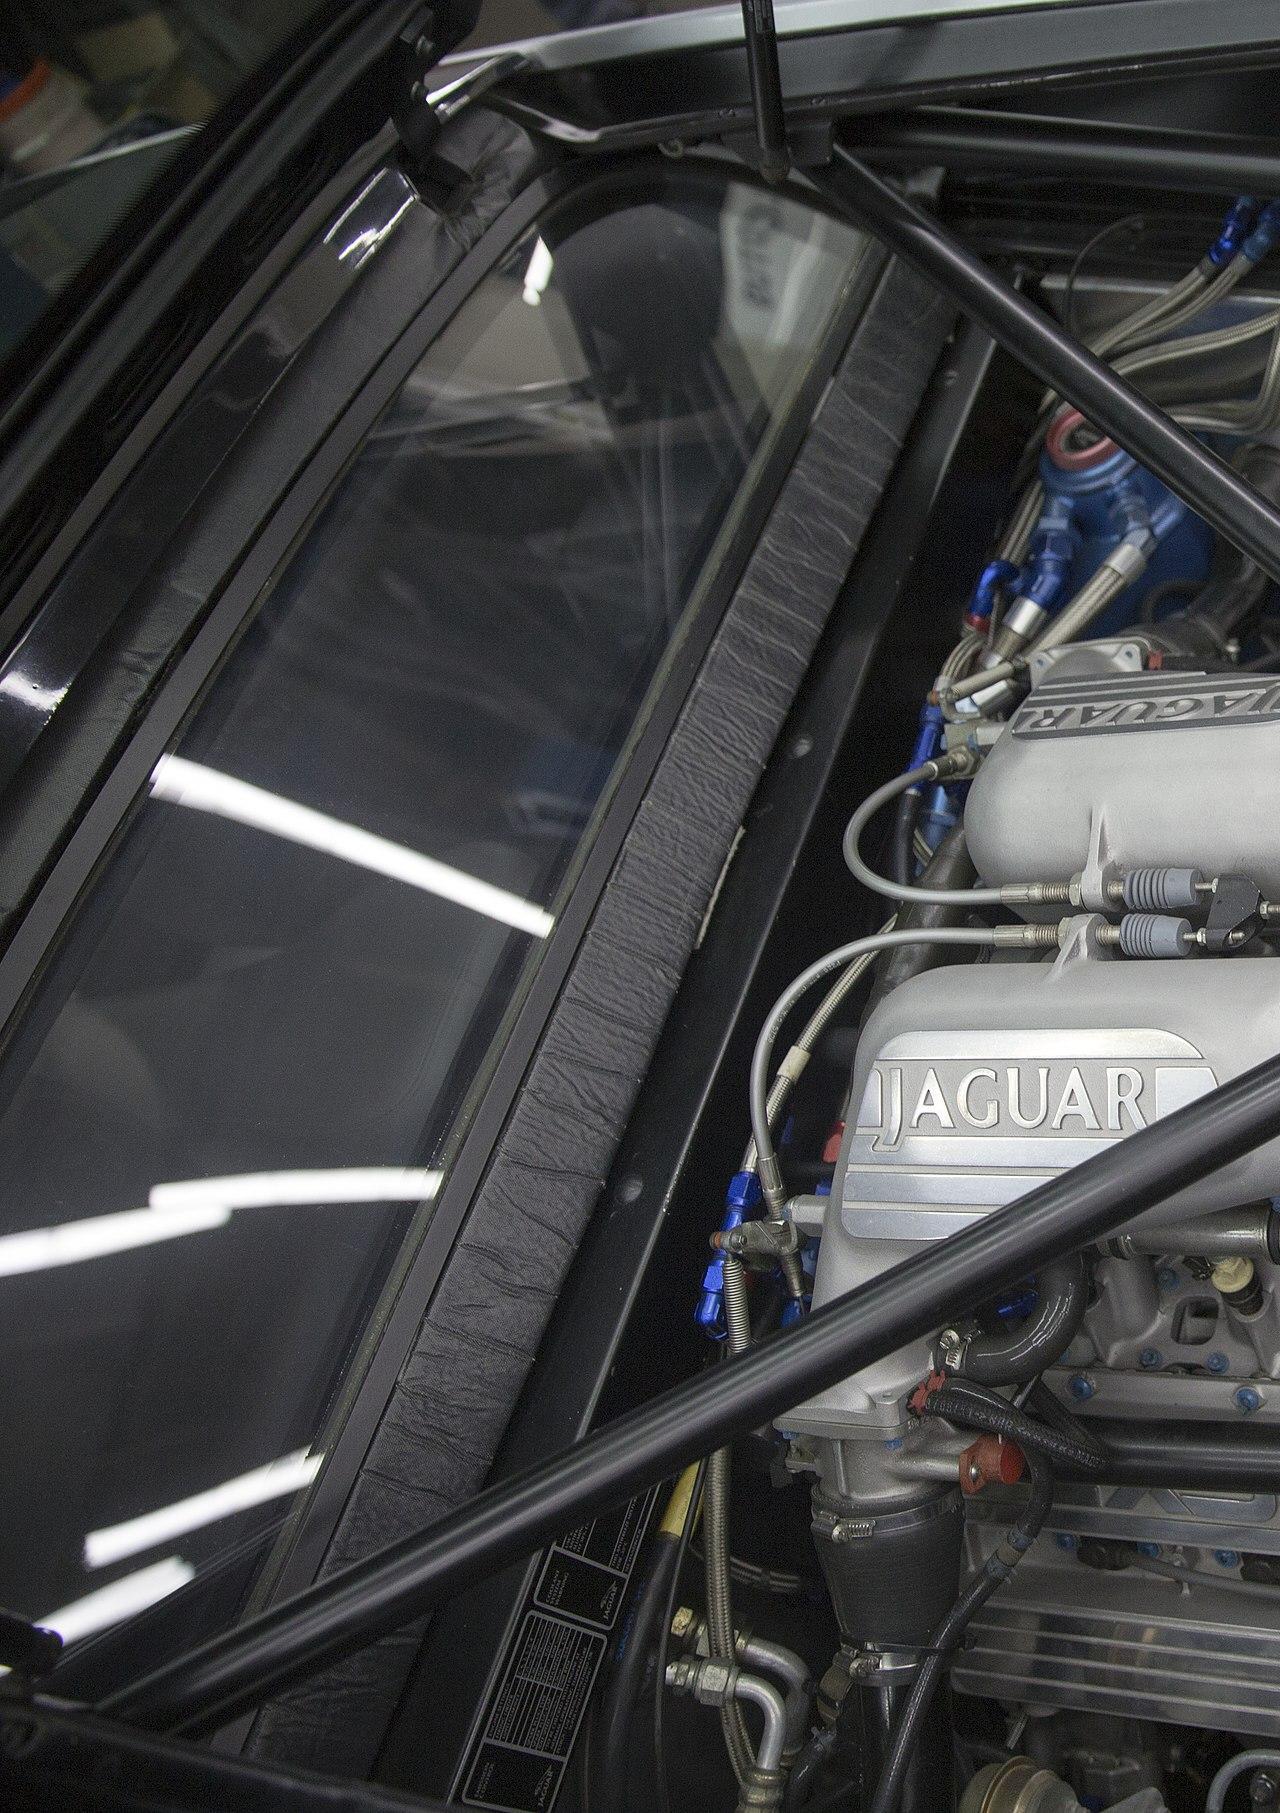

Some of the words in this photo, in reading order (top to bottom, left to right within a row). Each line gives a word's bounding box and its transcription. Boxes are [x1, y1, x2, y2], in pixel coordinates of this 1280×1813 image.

[880, 1066, 1148, 1147] JAGUAR
[601, 1584, 619, 1620] JAGUAR
[536, 1768, 556, 1807] JAGUAR
